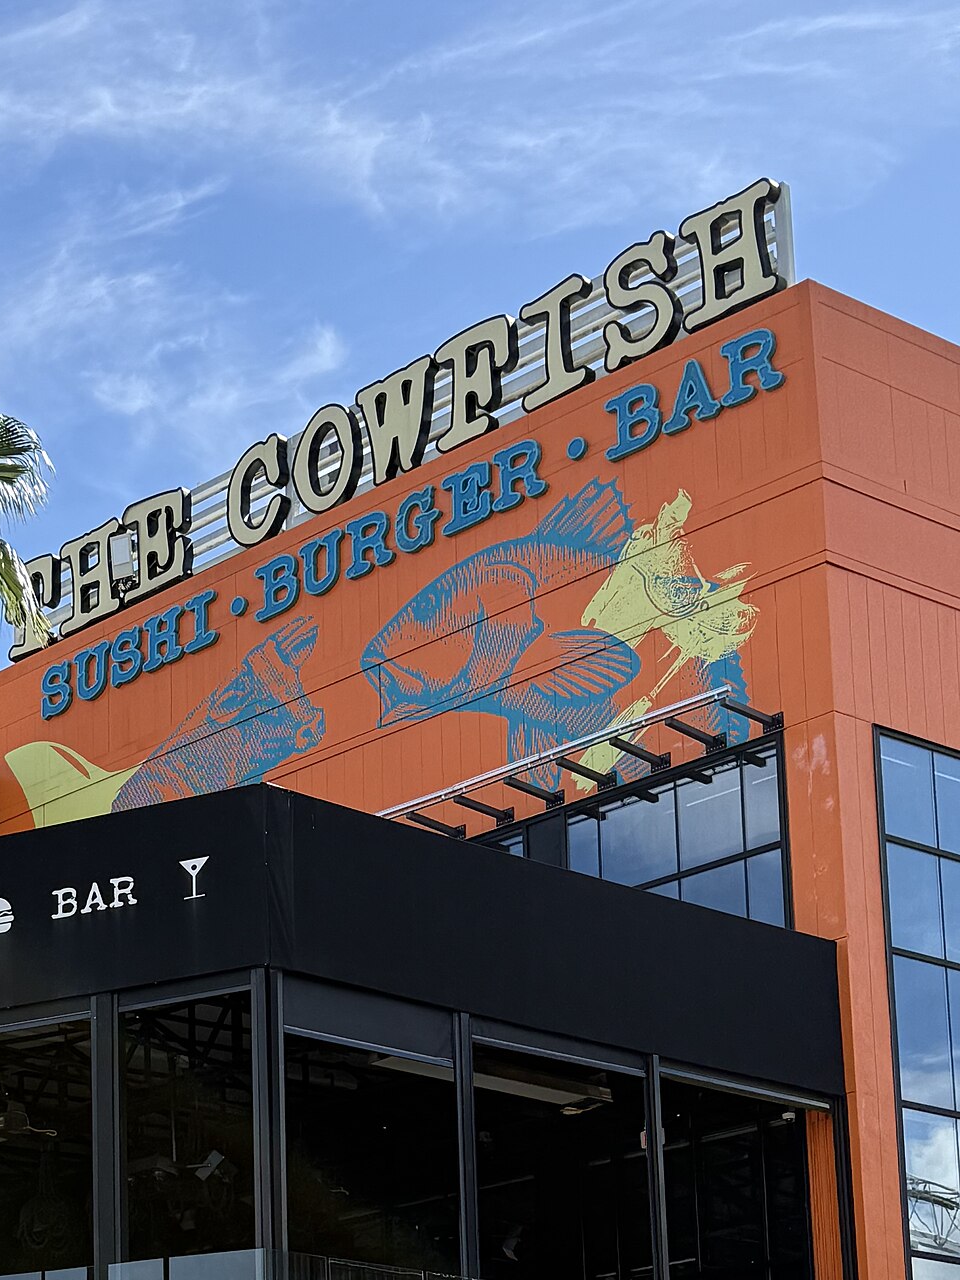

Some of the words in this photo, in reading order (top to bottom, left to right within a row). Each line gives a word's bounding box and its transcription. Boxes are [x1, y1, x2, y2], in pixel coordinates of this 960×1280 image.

[41, 588, 220, 721] SUSHI
[254, 438, 550, 624] BURGER
[605, 327, 786, 463] BAR
[227, 176, 788, 548] COWFISH
[51, 876, 138, 920] BAR
